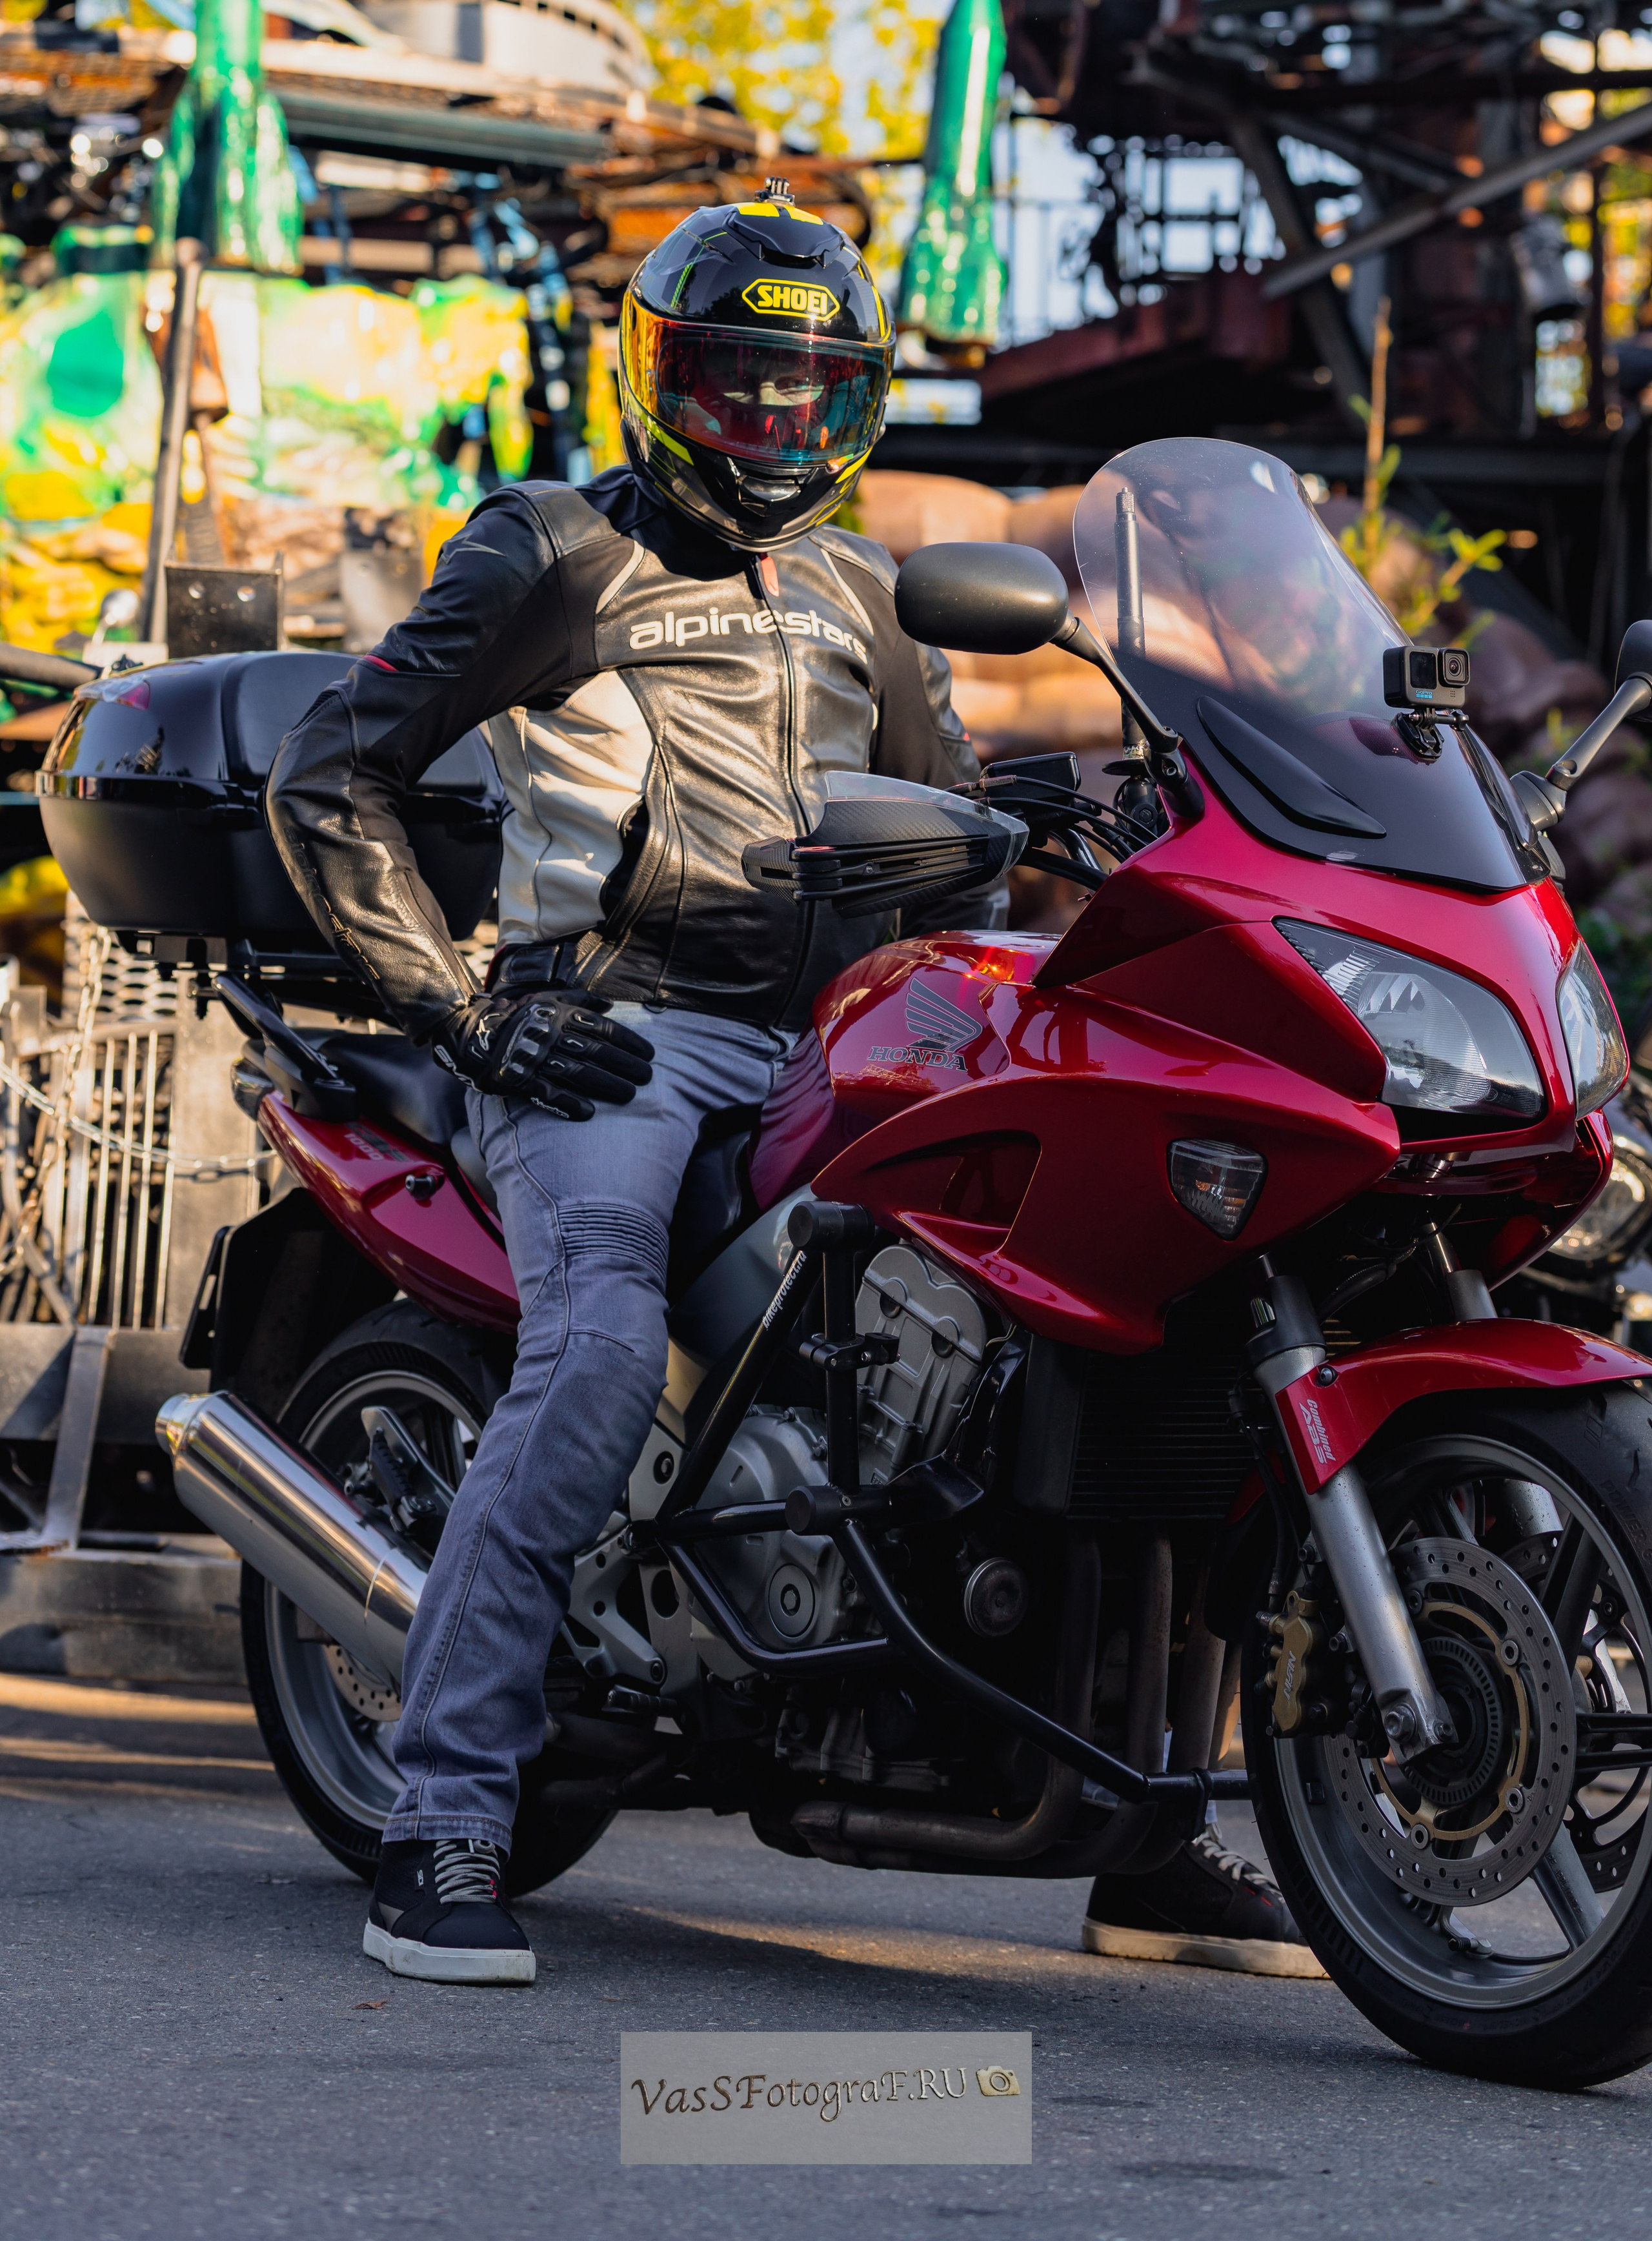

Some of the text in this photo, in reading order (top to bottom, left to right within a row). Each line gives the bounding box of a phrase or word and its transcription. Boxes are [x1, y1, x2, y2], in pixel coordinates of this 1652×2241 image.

[757, 285, 828, 315] SHOEI
[629, 607, 869, 665] alpinestars
[867, 1046, 968, 1072] HONDA
[343, 1133, 385, 1161] 1000
[763, 1251, 807, 1330] bikeprotect.ru
[1299, 1402, 1327, 1465] ABS
[1307, 1399, 1336, 1462] Combined
